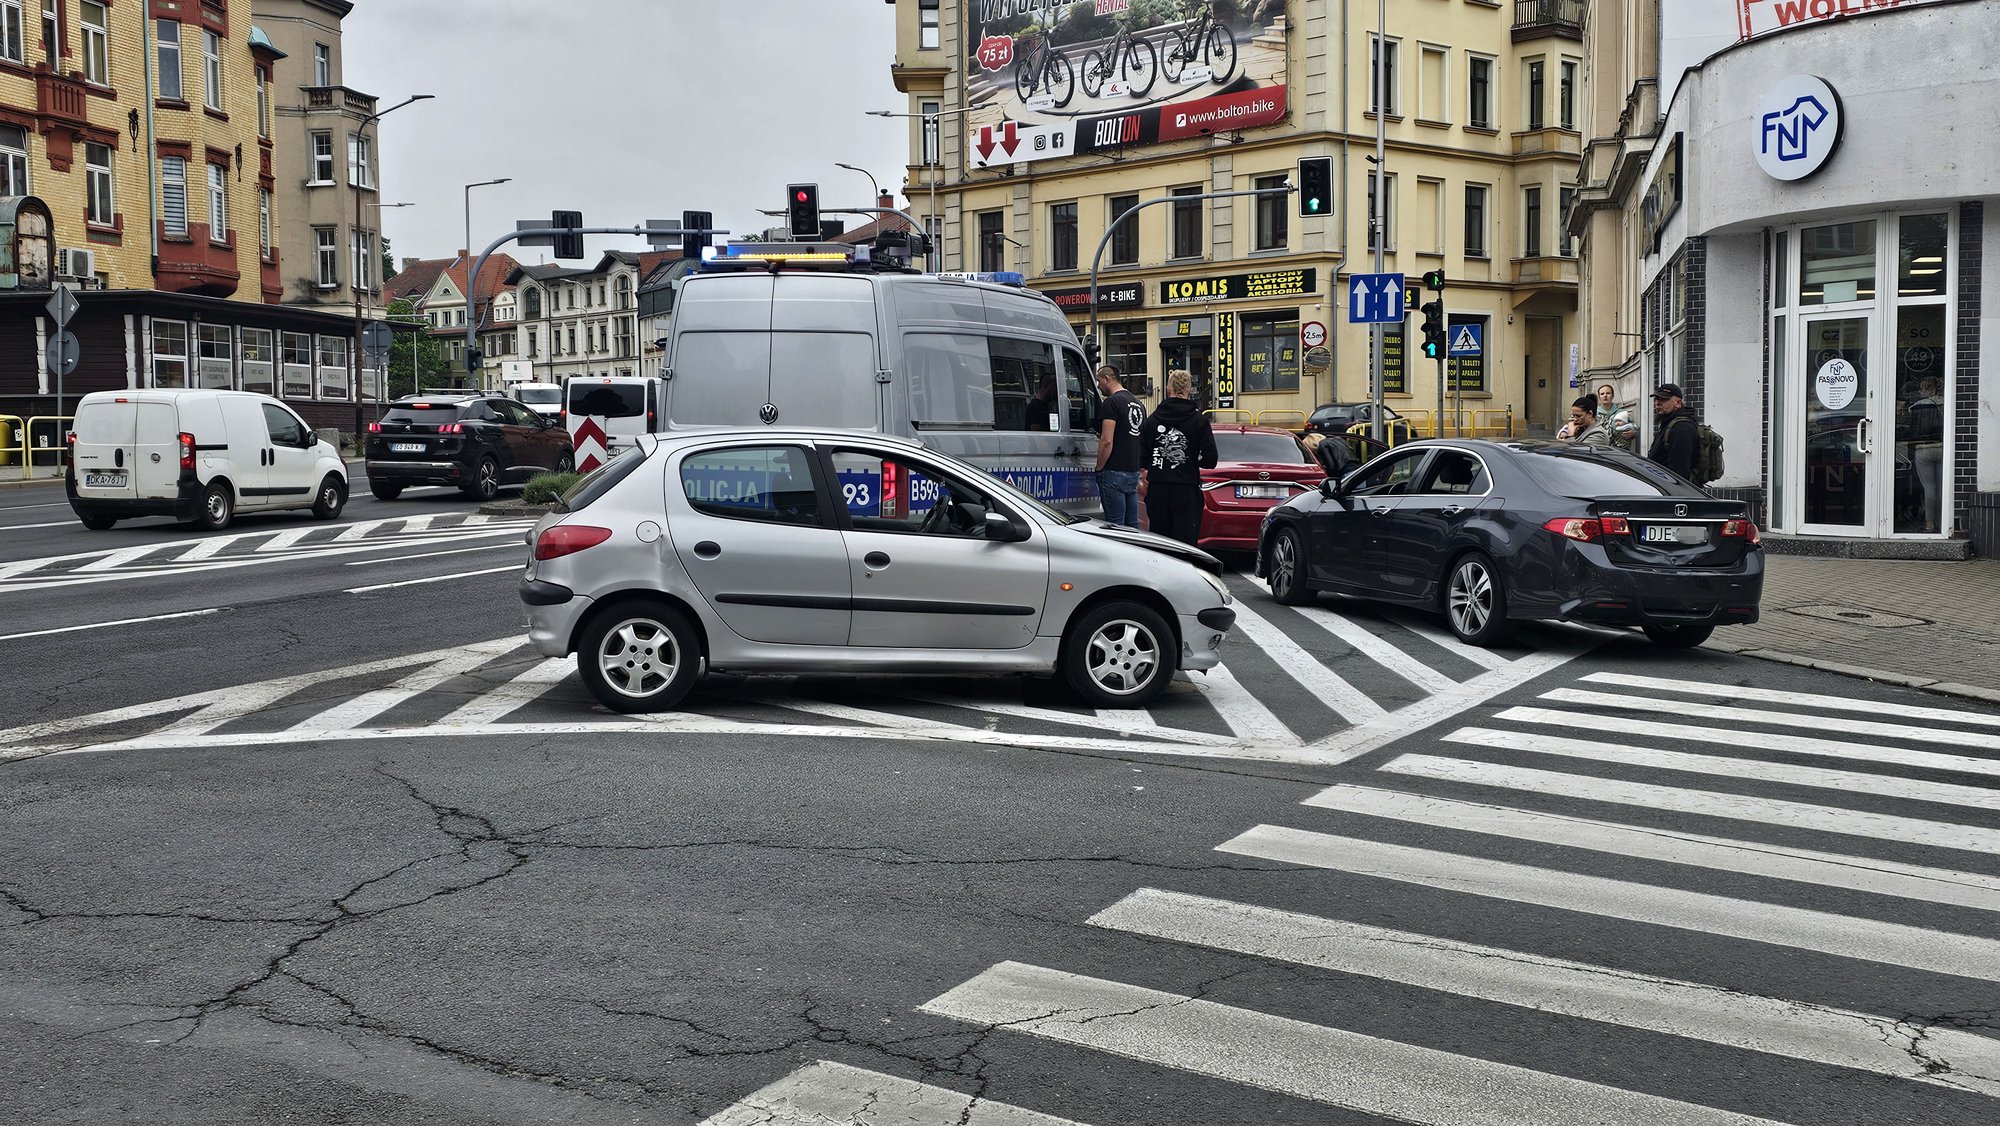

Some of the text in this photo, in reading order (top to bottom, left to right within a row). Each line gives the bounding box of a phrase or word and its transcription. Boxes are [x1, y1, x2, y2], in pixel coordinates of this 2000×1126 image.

[983, 45, 1008, 63] 75 zł
[1189, 99, 1275, 125] www.bolton.bike
[1094, 114, 1141, 147] BOLTON
[1168, 278, 1228, 299] KOMIS
[1246, 276, 1304, 286] LAPTOPY
[1247, 282, 1304, 291] TABLETY
[1055, 292, 1092, 305] ROWEROW
[1110, 289, 1136, 302] E-BIKE
[1247, 287, 1304, 297] AKCESORIA
[91, 475, 105, 485] DKA
[687, 479, 760, 504] OLICJA
[842, 483, 870, 506] 93
[911, 479, 939, 501] B593
[1648, 527, 1672, 541] DJE
